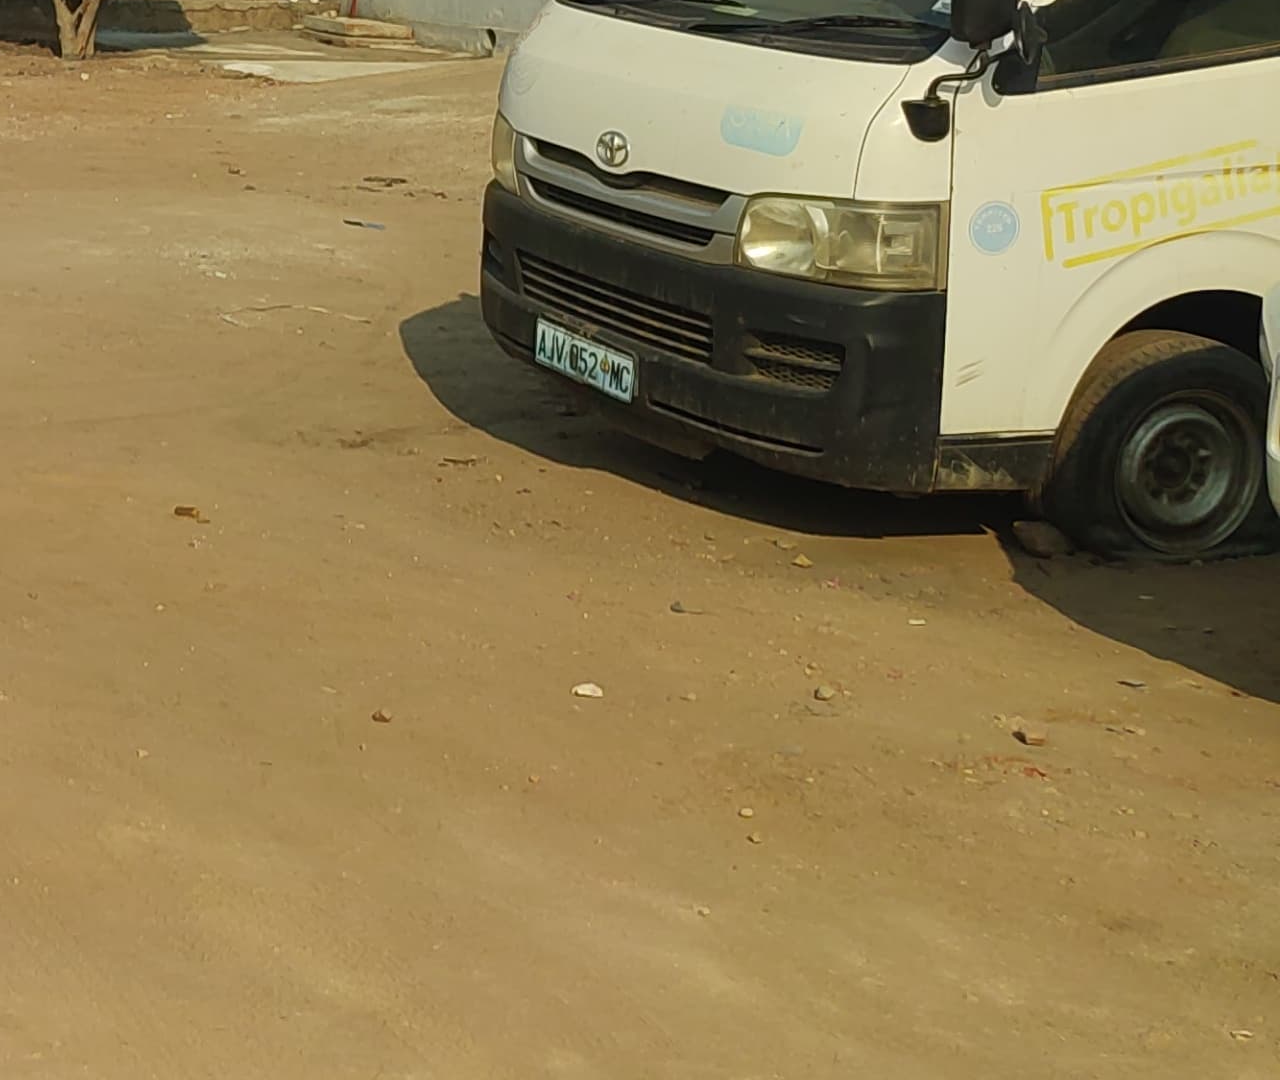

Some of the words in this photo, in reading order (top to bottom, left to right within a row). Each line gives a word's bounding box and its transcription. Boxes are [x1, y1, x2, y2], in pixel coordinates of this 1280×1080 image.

[1056, 155, 1272, 243] Tropigalia
[538, 330, 565, 364] AJV
[570, 344, 597, 380] 052
[609, 360, 630, 394] MC
